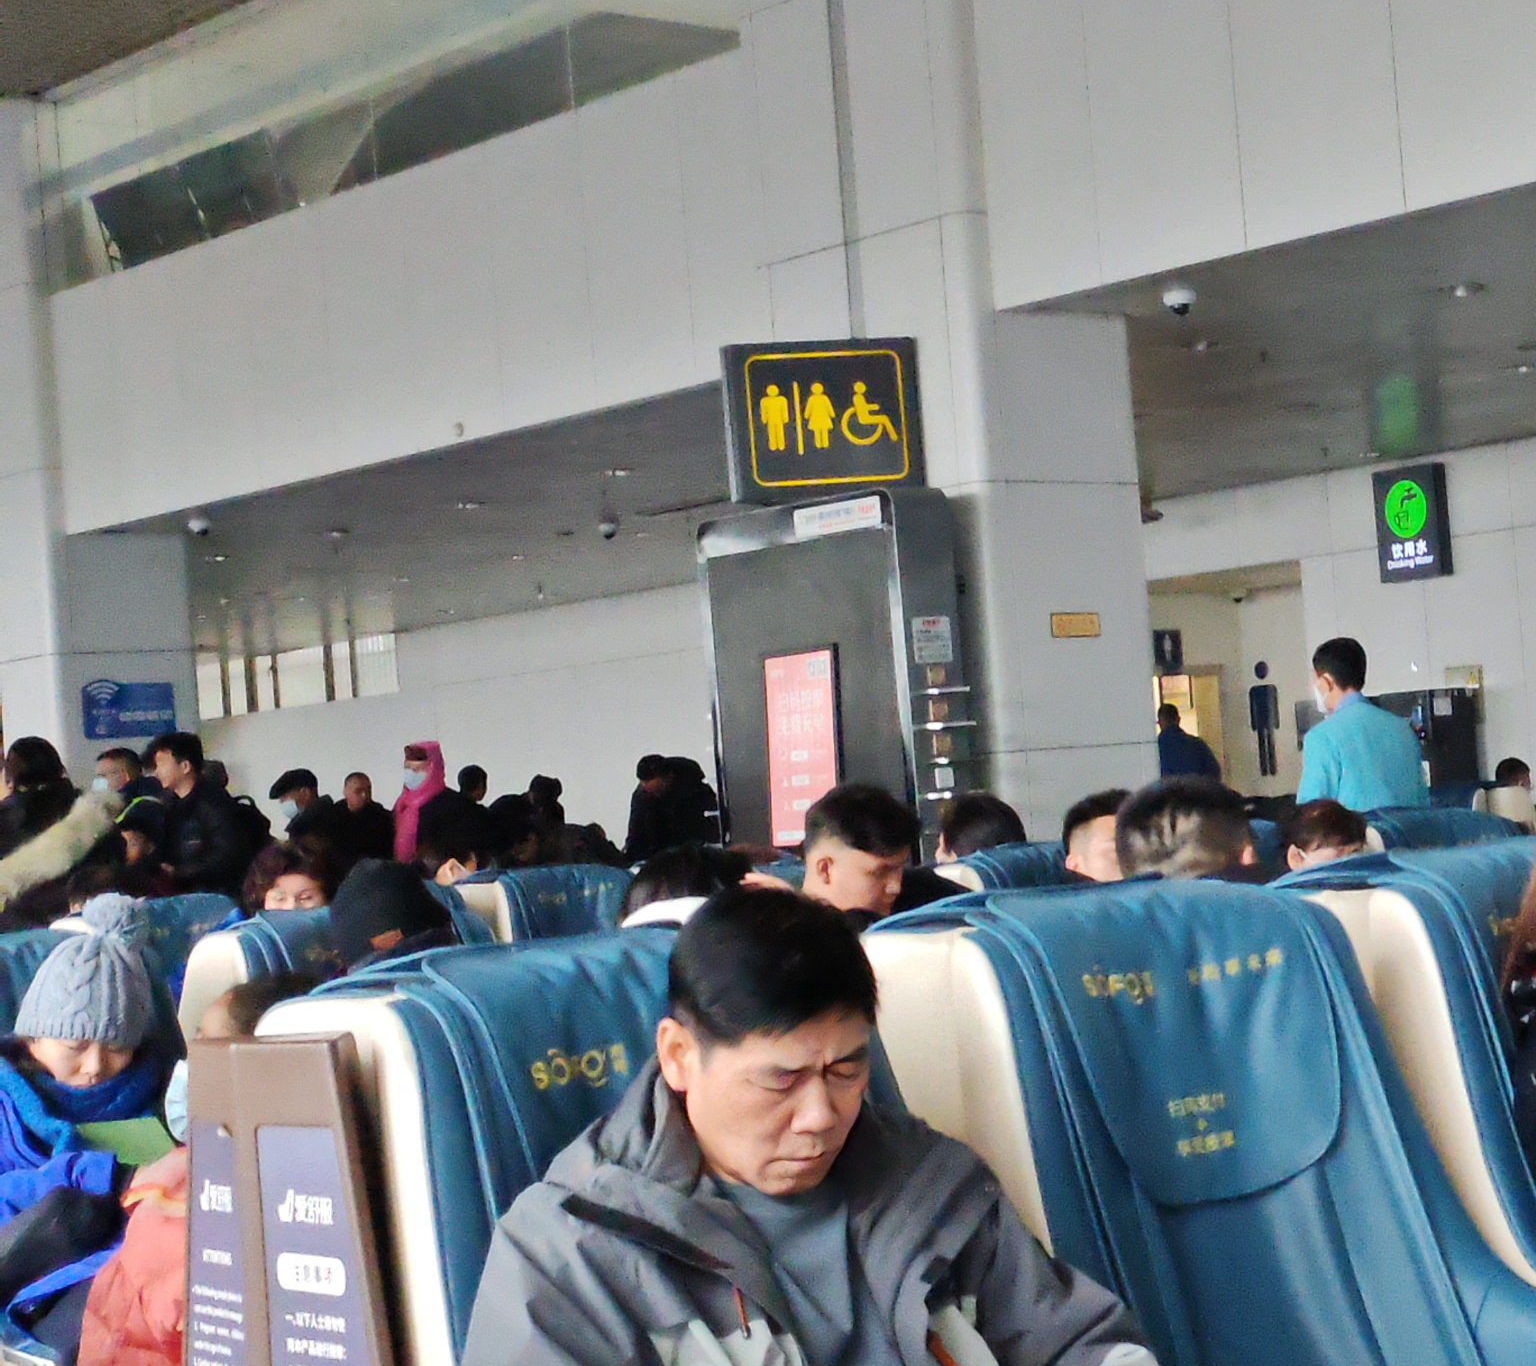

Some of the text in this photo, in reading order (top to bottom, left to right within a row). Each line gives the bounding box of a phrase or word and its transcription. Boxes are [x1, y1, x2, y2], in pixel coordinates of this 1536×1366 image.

[1392, 539, 1428, 559] 饮用水
[294, 1195, 333, 1225] 爱舒服
